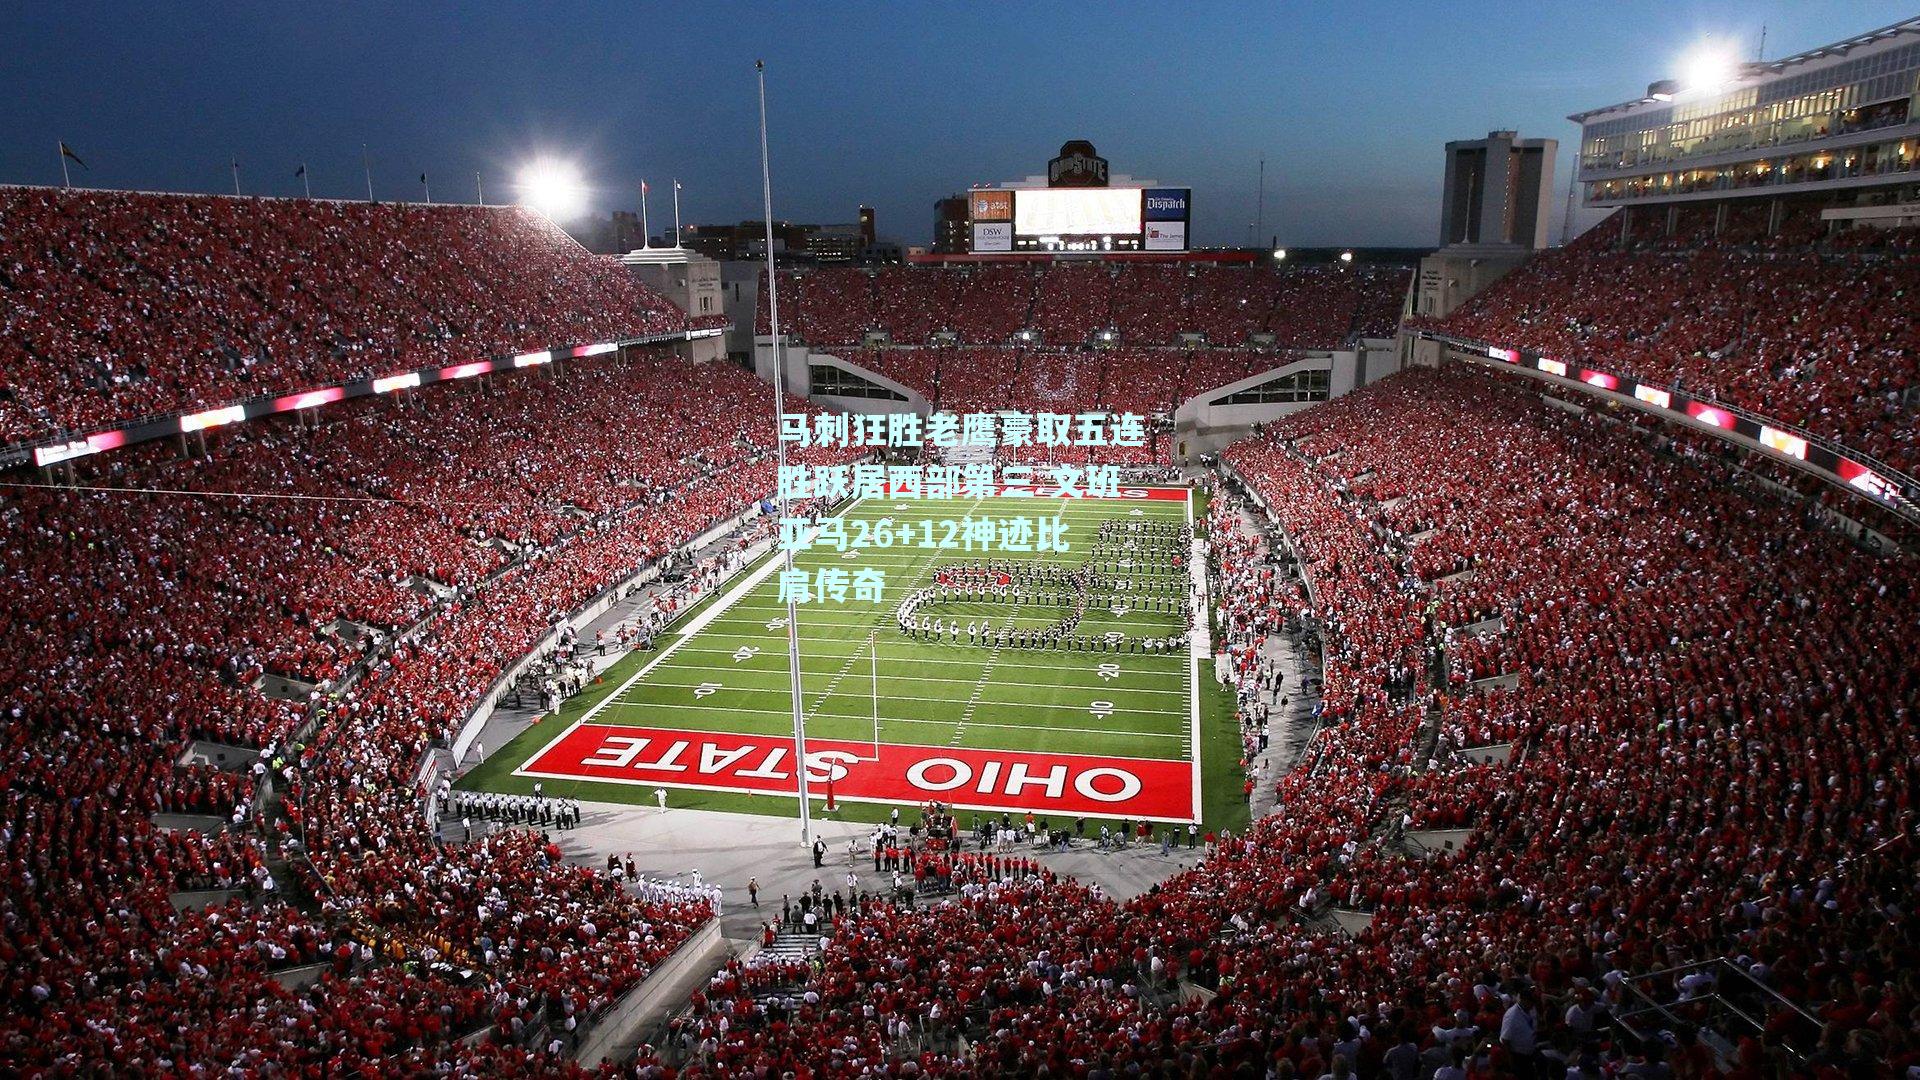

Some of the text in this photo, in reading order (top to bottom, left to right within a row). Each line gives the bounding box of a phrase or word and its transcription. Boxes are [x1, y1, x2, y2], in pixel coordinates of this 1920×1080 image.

[1147, 198, 1185, 210] Dispatch
[1097, 664, 1120, 678] 20
[1089, 701, 1114, 715] 10
[580, 736, 1142, 802] OHIO STATE
